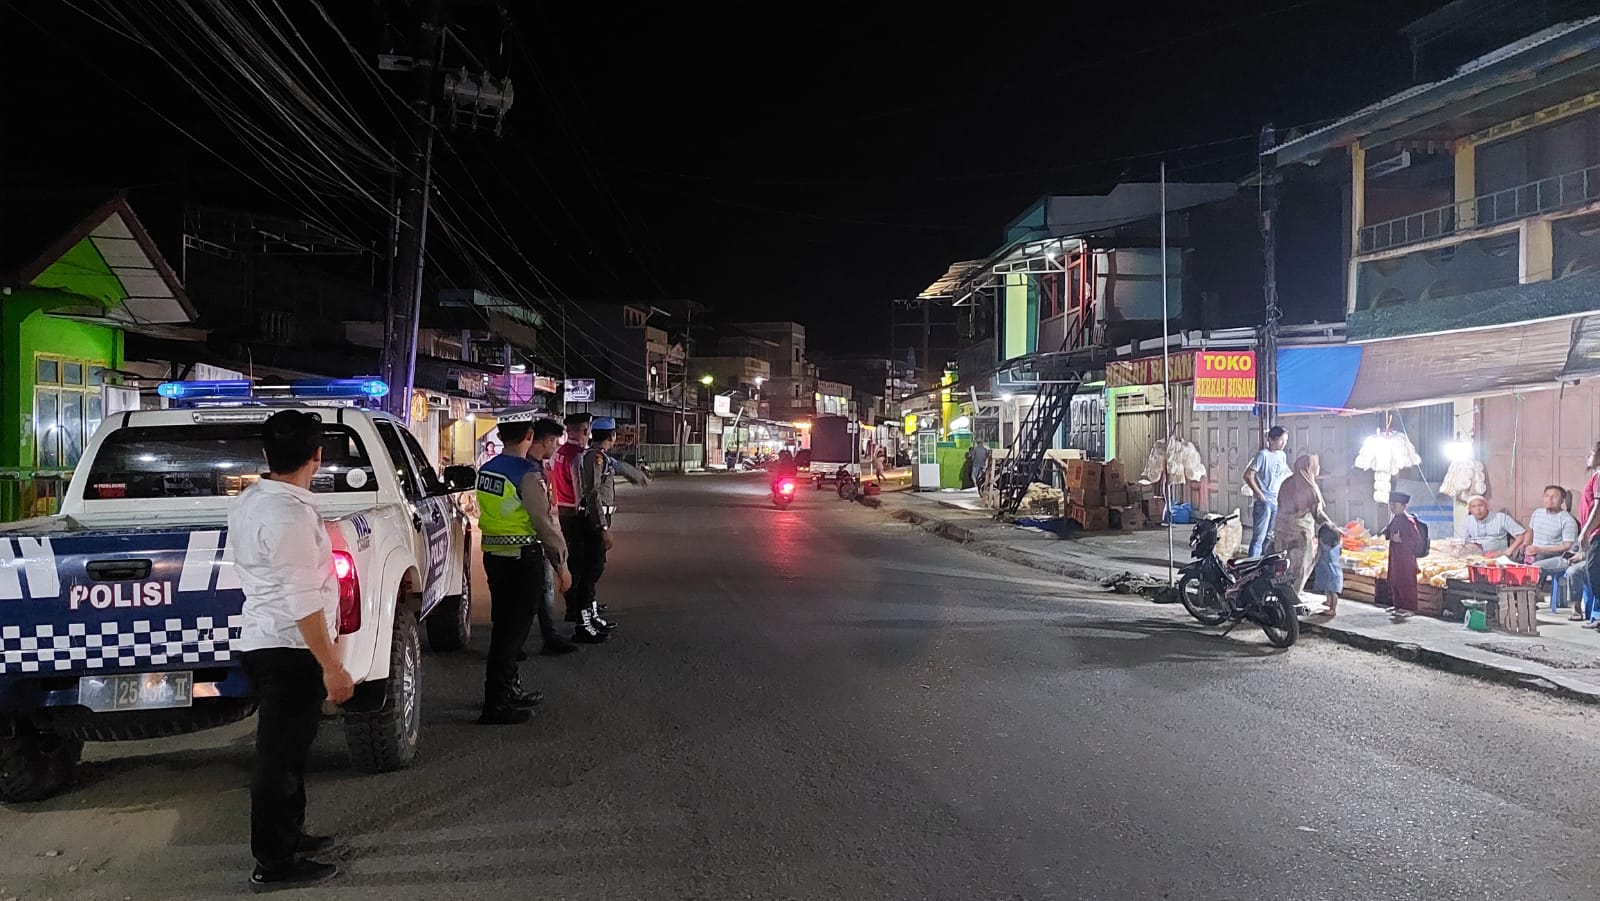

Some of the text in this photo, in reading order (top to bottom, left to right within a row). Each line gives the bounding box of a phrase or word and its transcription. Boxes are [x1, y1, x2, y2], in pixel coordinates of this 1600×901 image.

[1203, 355, 1252, 371] TOKO
[480, 474, 503, 494] POLISI
[70, 581, 172, 609] POLISI
